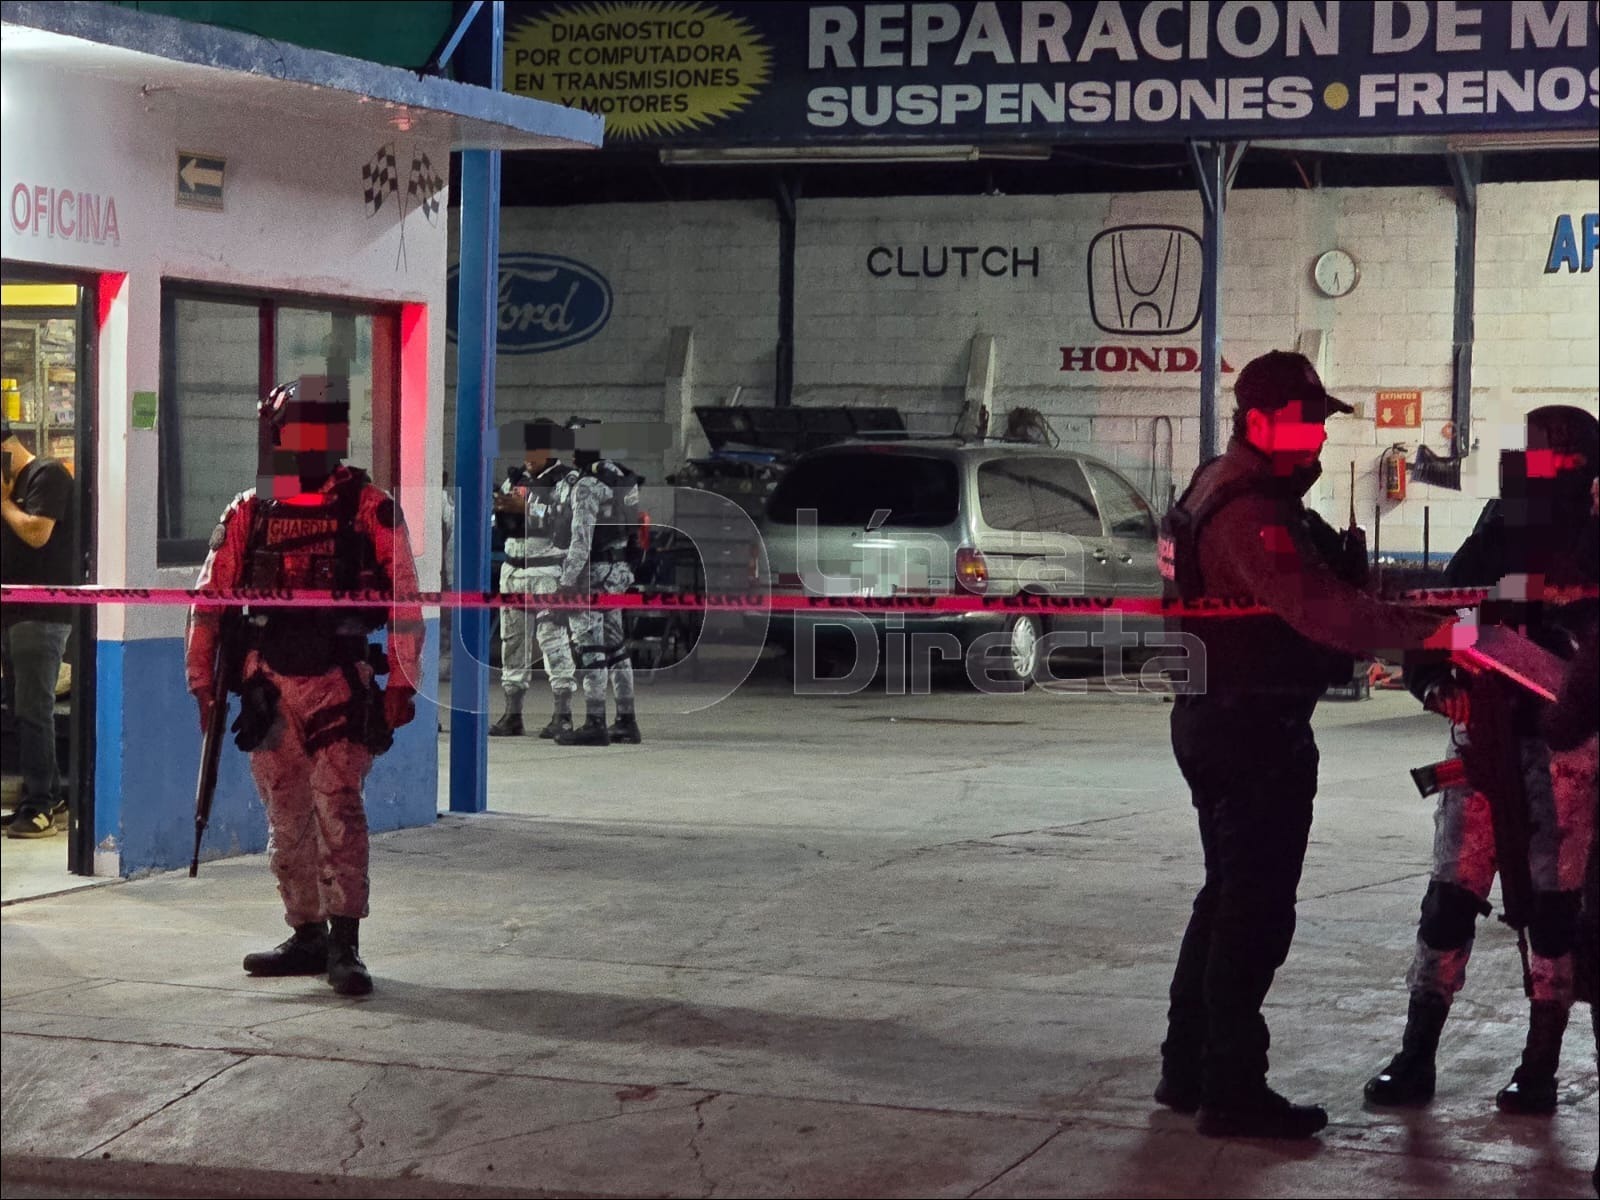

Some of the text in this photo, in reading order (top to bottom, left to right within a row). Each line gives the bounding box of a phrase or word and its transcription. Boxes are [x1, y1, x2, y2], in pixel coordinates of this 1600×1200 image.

[551, 20, 705, 43] DIAGNOSTICO
[808, 1, 1599, 69] REPARACION DE M
[514, 44, 742, 67] POR COMPUTADORA
[514, 68, 740, 91] EN TRANSMISIONES
[560, 94, 689, 113] Y MOTORES
[807, 67, 1599, 127] SUSPENSIONES FRENO
[11, 182, 121, 244] OFICINA
[867, 246, 1040, 279] CLUTCH
